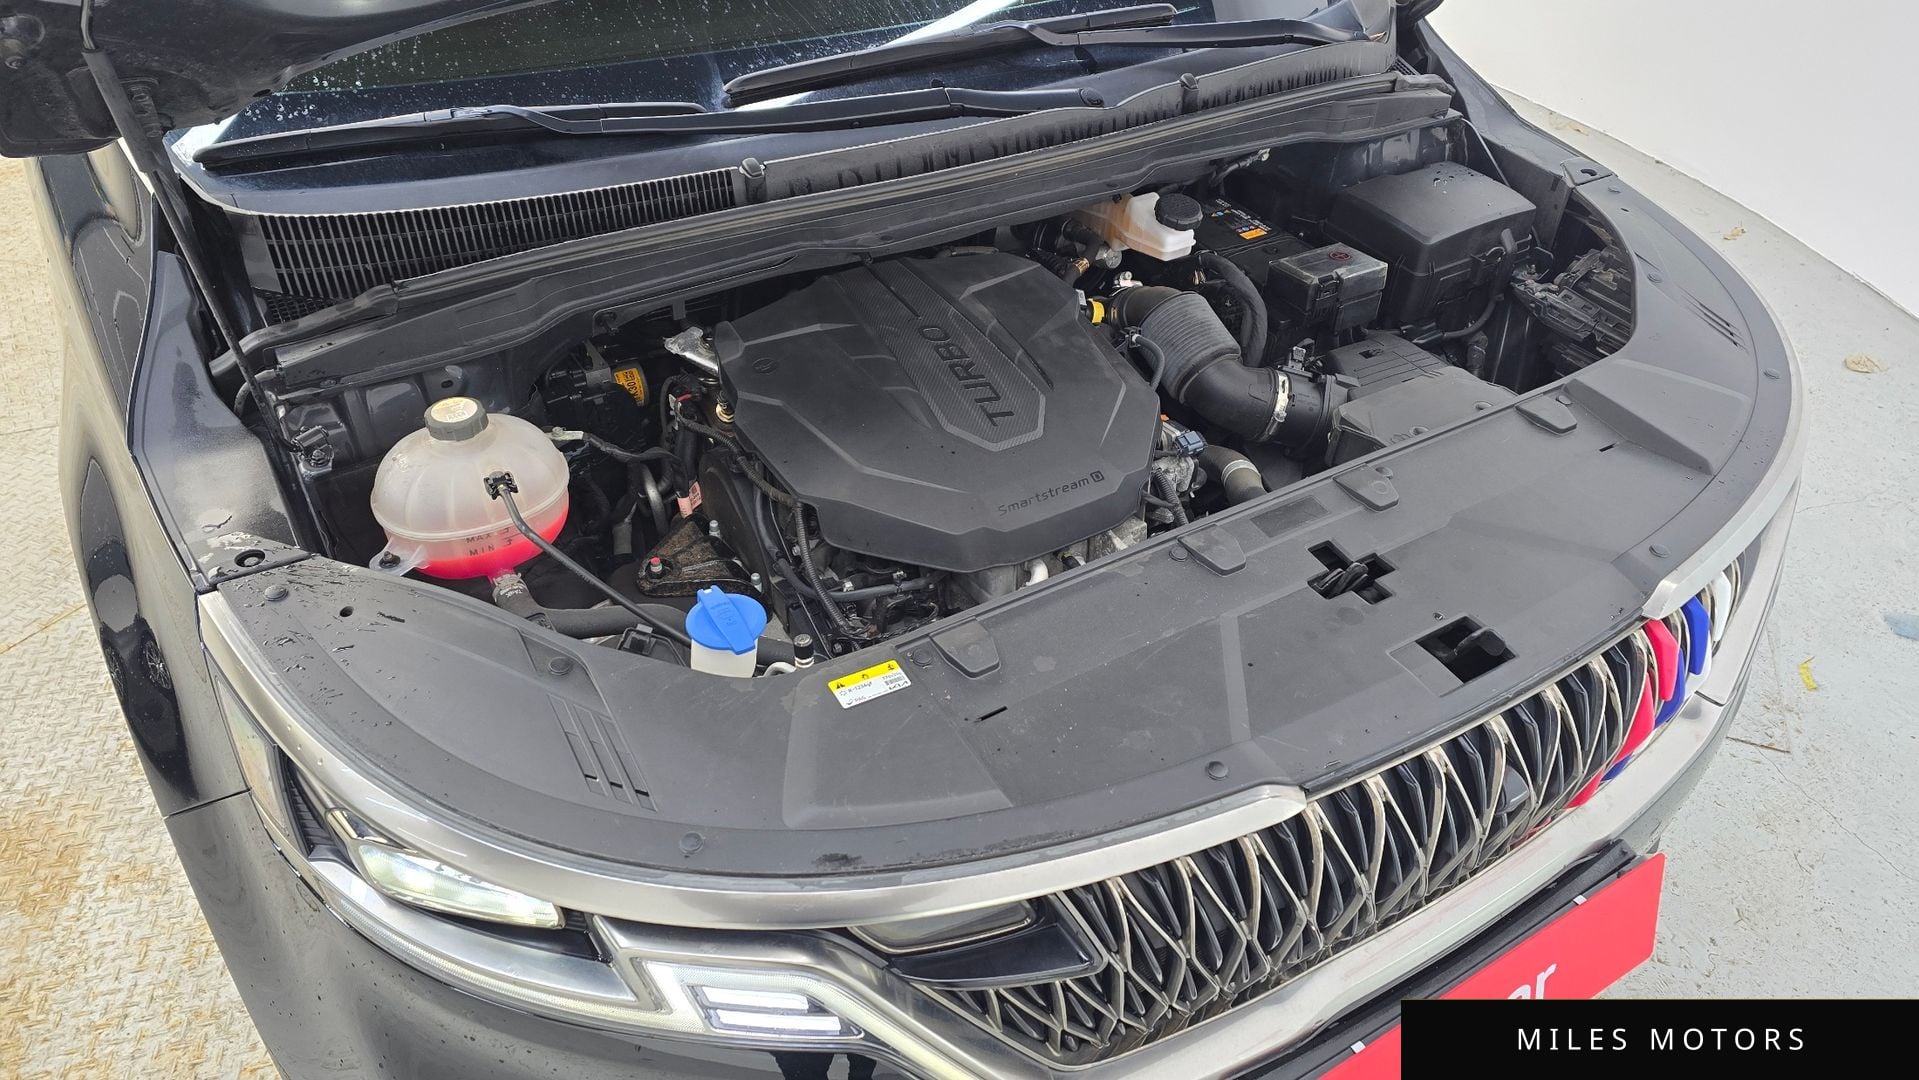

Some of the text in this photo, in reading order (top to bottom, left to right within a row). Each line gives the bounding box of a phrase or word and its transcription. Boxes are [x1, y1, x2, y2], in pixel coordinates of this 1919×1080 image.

[918, 325, 1015, 427] TURBO
[998, 476, 1090, 516] Smartstream
[465, 532, 492, 543] MAX
[469, 545, 495, 556] MIN
